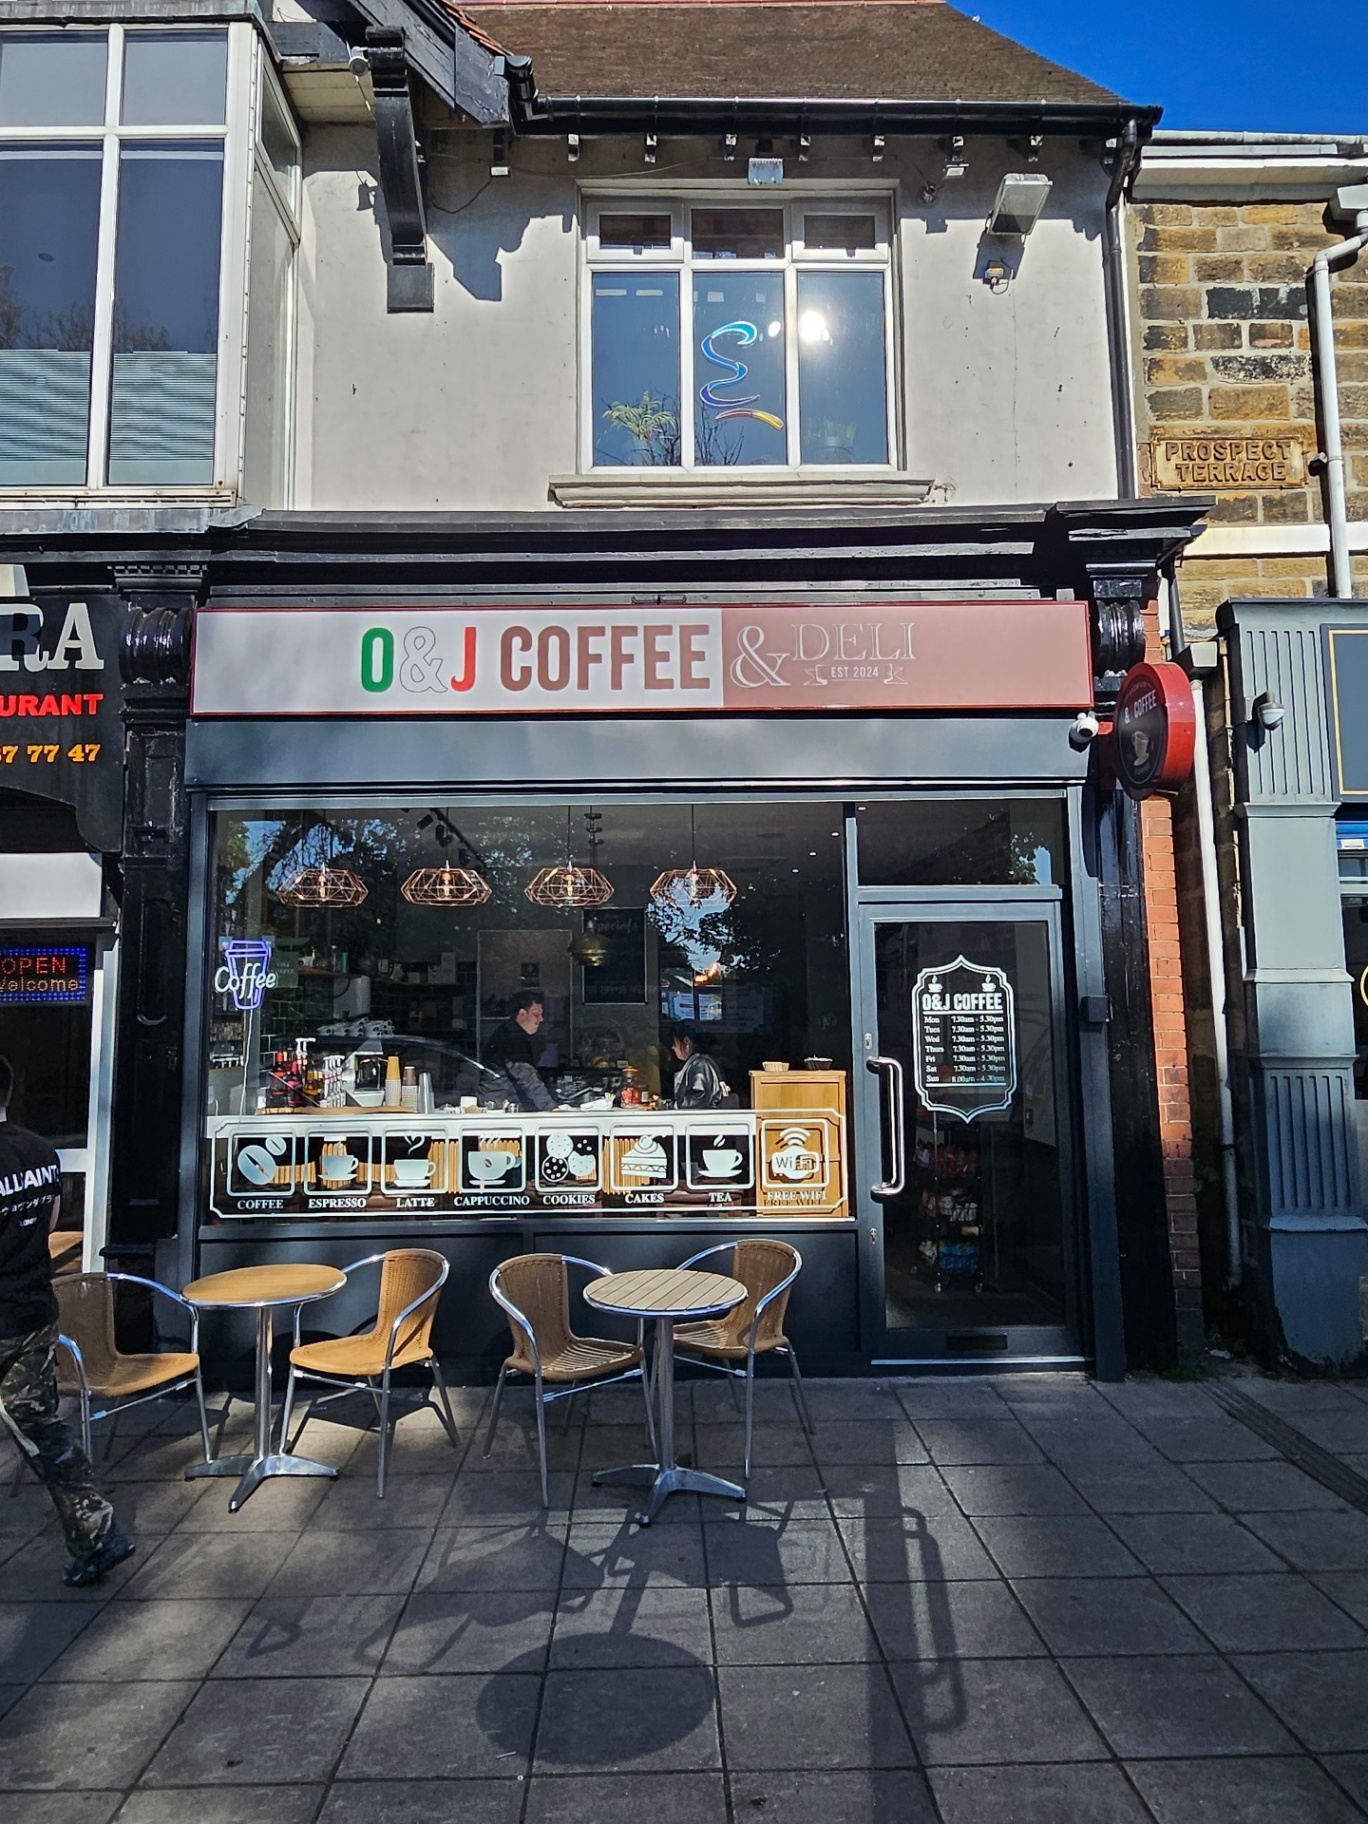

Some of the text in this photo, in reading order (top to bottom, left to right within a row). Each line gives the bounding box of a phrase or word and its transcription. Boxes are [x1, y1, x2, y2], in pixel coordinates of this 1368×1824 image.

[1165, 441, 1291, 461] PROSPECT
[1175, 462, 1286, 482] TERRACE
[0, 602, 104, 672] RA
[361, 622, 917, 693] O&J COFFEE & DELI
[831, 666, 879, 678] EST 2024
[1133, 689, 1157, 718] COFFEE
[0, 743, 100, 763] 7 77 47
[1, 956, 66, 974] OPEN
[215, 963, 276, 1000] Coffee
[922, 993, 1003, 1010] O&J COFFEE
[951, 1015, 974, 1023] 7.30am
[980, 1015, 1004, 1024] 5.30pm
[951, 1025, 975, 1033] 7.30am
[980, 1025, 1004, 1033] 5.30pm
[951, 1035, 975, 1043] 7.30am
[980, 1035, 1004, 1043] 5.30pm
[981, 1045, 1005, 1053] 5.30pm
[981, 1055, 1005, 1063] 5.30pm
[925, 1065, 937, 1073] Sat
[953, 1064, 976, 1072] 7.30am
[981, 1064, 1006, 1073] 5.30pm
[453, 1195, 530, 1206] CAPPUCCINO
[543, 1194, 596, 1205] COOKIES
[625, 1193, 665, 1204] CAKES
[708, 1192, 732, 1202] TEA
[767, 1190, 826, 1201] FREE WIFI
[237, 1199, 283, 1209] COFFEE
[308, 1197, 367, 1208] ESPRESSO
[396, 1197, 435, 1207] LATTE
